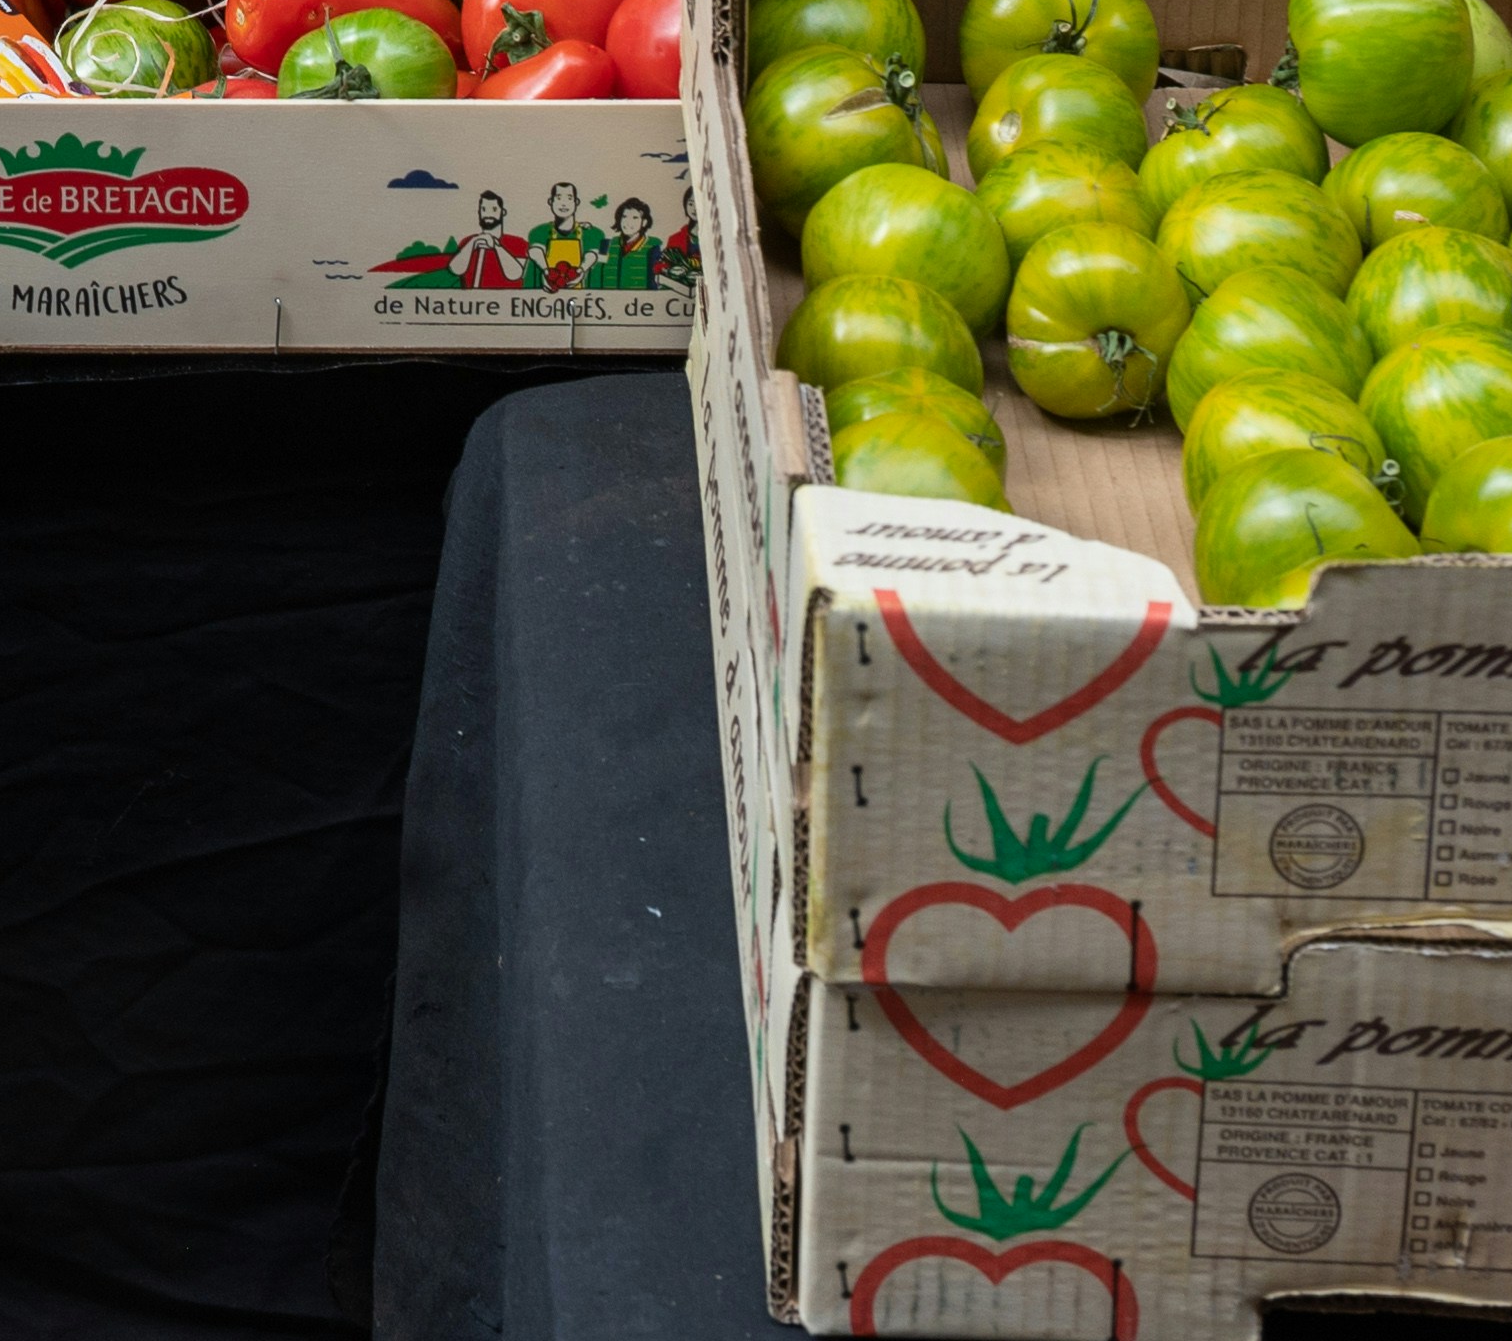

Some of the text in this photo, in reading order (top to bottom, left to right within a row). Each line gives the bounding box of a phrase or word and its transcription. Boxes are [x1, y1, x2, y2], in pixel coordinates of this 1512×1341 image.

[22, 189, 53, 213] de
[59, 184, 238, 214] BRETAGNE
[11, 275, 188, 317] MARAÎCHERS
[374, 296, 407, 317] de
[413, 295, 500, 317] Nature
[624, 296, 655, 317] de
[1237, 626, 1347, 672] la
